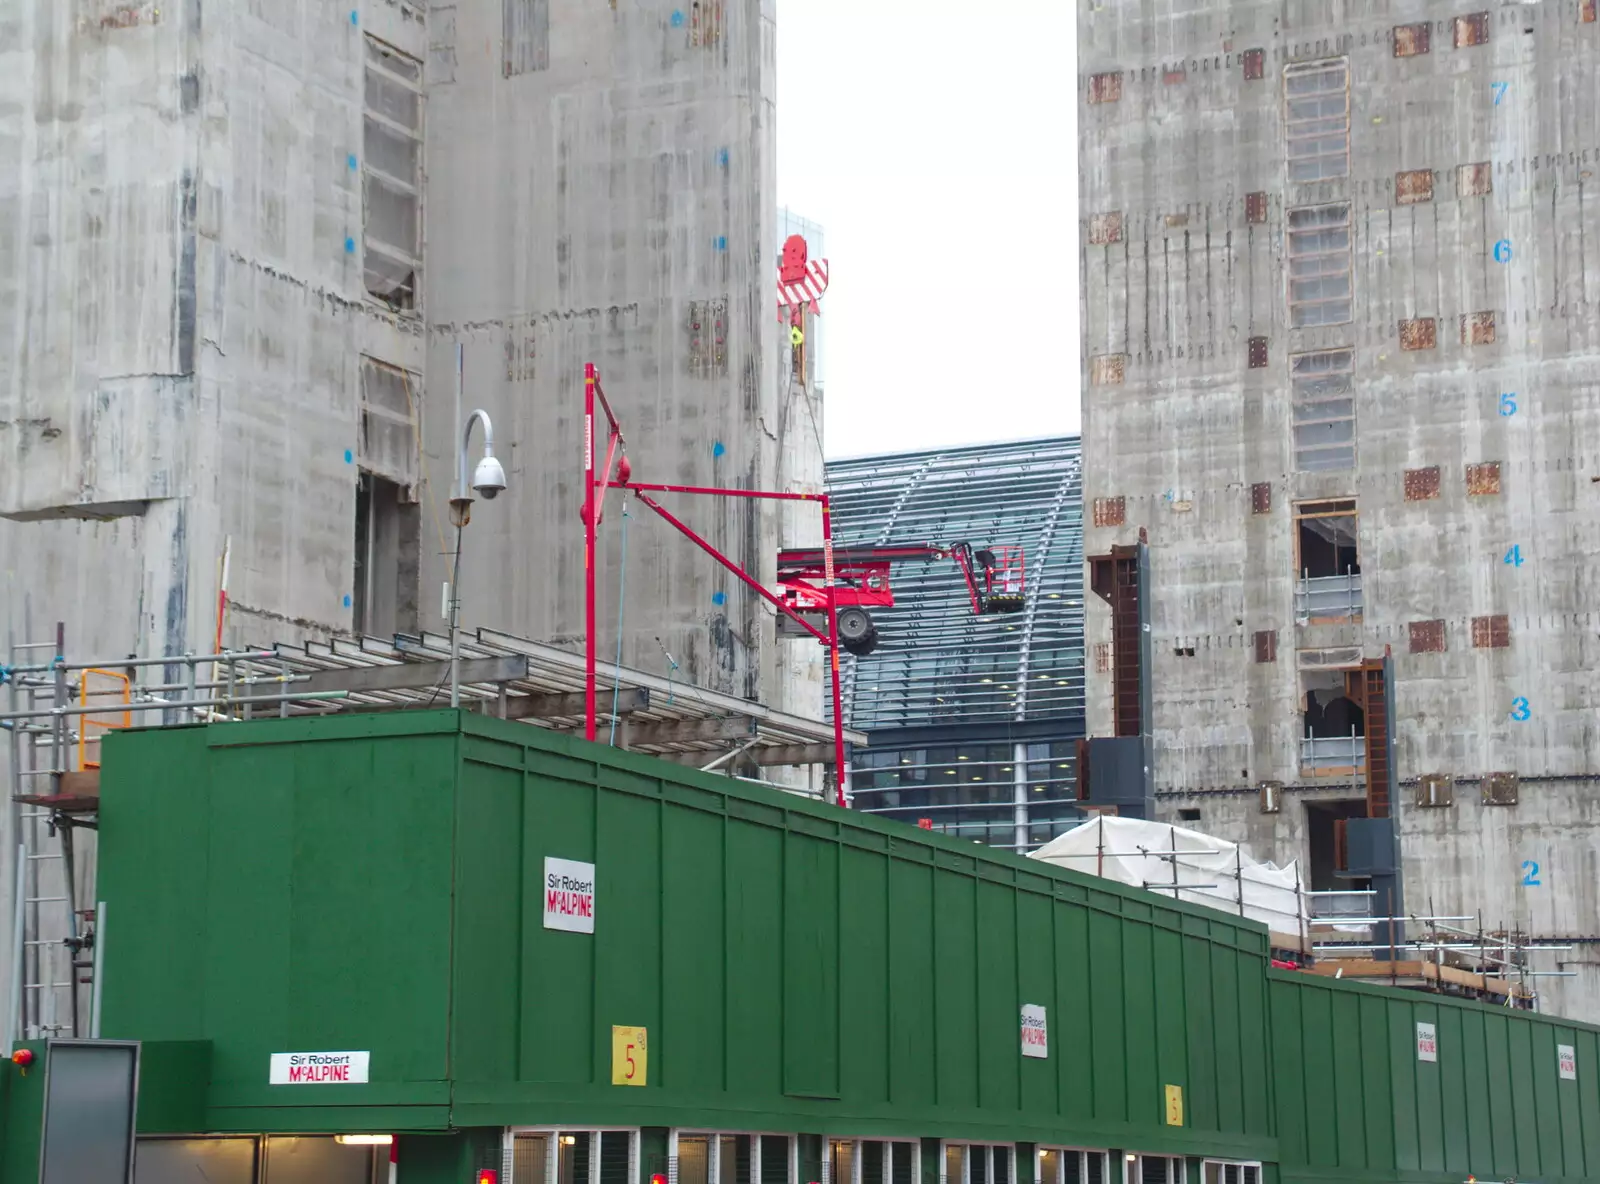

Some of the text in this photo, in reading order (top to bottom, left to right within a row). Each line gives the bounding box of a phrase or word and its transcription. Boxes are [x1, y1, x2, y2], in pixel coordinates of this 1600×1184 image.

[1490, 81, 1509, 105] 7
[1493, 238, 1513, 264] 6
[1499, 392, 1518, 417] 5
[1503, 544, 1525, 567] 4
[1511, 696, 1531, 721] 3
[548, 873, 592, 893] Sir Robert
[1521, 859, 1541, 886] 2
[290, 1055, 350, 1065] Sir Robert
[625, 1044, 635, 1079] 5
